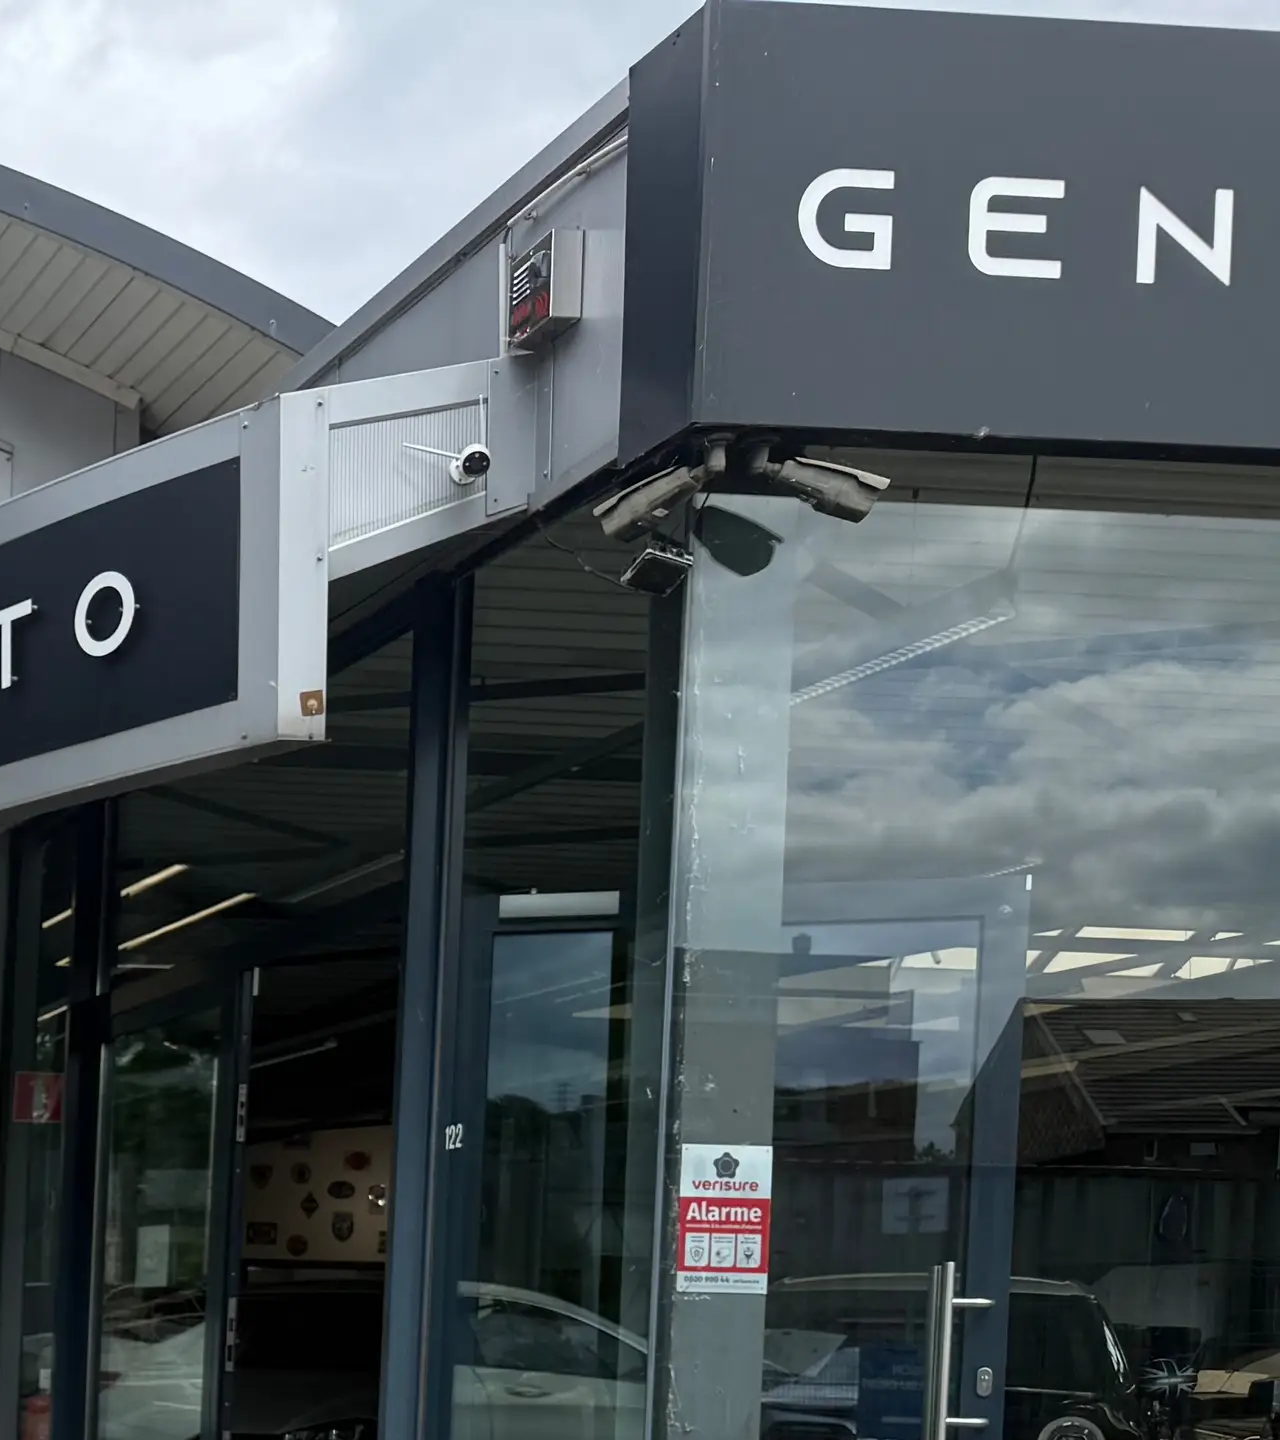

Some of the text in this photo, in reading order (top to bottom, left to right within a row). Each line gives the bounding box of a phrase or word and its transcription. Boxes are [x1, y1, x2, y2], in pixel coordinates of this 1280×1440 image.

[798, 168, 1234, 286] GEN
[445, 1123, 463, 1150] 122
[692, 1179, 759, 1192] verisure
[686, 1201, 762, 1222] Alarme
